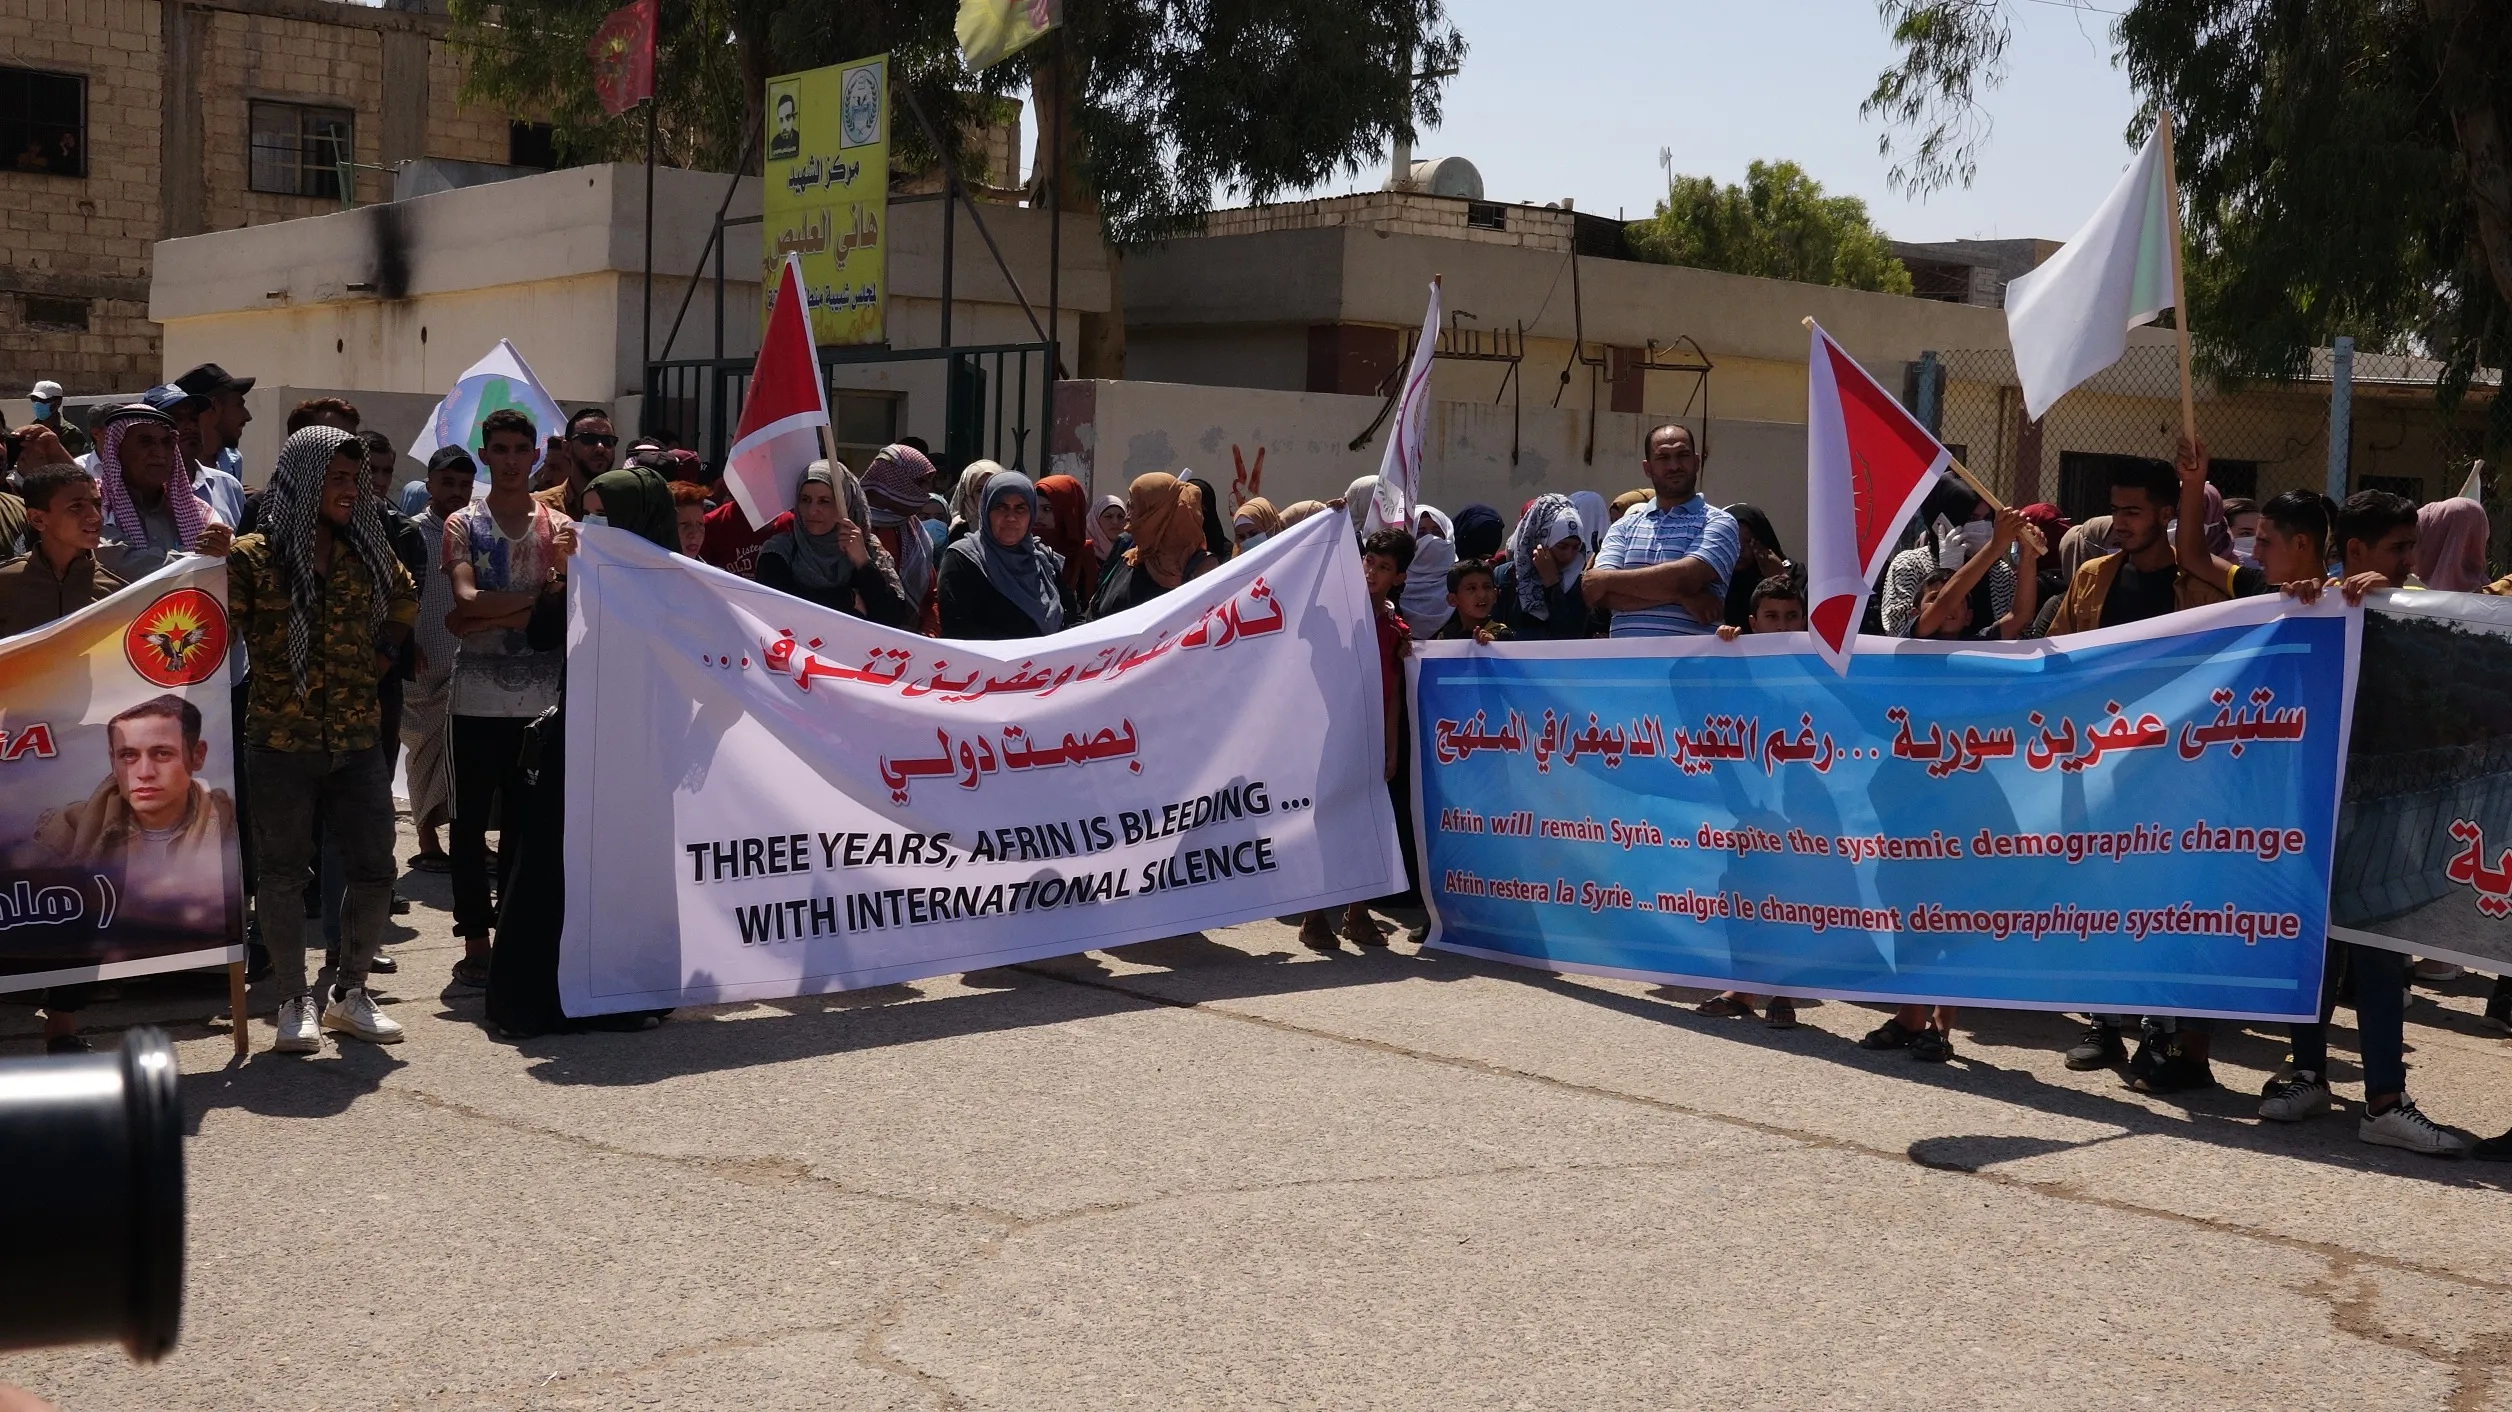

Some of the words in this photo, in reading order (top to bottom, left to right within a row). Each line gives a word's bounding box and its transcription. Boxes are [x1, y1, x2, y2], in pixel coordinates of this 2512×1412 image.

[787, 154, 823, 195] الشهيد
[824, 154, 860, 188] مركز
[835, 203, 878, 270] هاني
[726, 558, 752, 574] OLD
[1180, 576, 1286, 649] ثلاث
[759, 628, 914, 693] تنزف
[900, 661, 1076, 703] وعفرين
[1074, 630, 1182, 683] سنوات
[999, 714, 1143, 776] بصمت
[1533, 711, 1667, 775] الديمغرافي
[1670, 712, 1759, 777] التغيير
[1885, 707, 2016, 779] سورية
[2024, 699, 2170, 774] عفرين
[2177, 686, 2307, 760] ستبقى
[879, 724, 999, 806] دولي
[686, 832, 812, 883] THREE
[817, 830, 960, 872] YEARS,
[968, 818, 1077, 865] AFRIN
[1078, 814, 1116, 852] IS
[1122, 780, 1272, 848] BLEEDING
[1440, 808, 1486, 836] Afrin
[1489, 811, 1535, 838] will
[1538, 815, 1606, 843] remain
[1609, 819, 1664, 852] Syria
[1696, 821, 1783, 859] despite
[1788, 828, 1832, 856] the
[1834, 829, 1963, 865] systemic
[1970, 822, 2175, 865] demographic
[2179, 818, 2306, 864] change
[734, 885, 837, 947] WITH
[846, 866, 1135, 934] INTERNATIONAL
[1138, 837, 1279, 893] SILENCE
[1444, 870, 1486, 898] Afrin
[1488, 878, 1551, 904] restera
[1553, 878, 1577, 906] la
[1579, 880, 1634, 913] Syrie
[1655, 888, 1730, 923] malgré
[1734, 891, 1756, 918] le
[1757, 897, 1903, 934] changement
[1908, 902, 2121, 942] démographique
[2124, 901, 2300, 945] systémique
